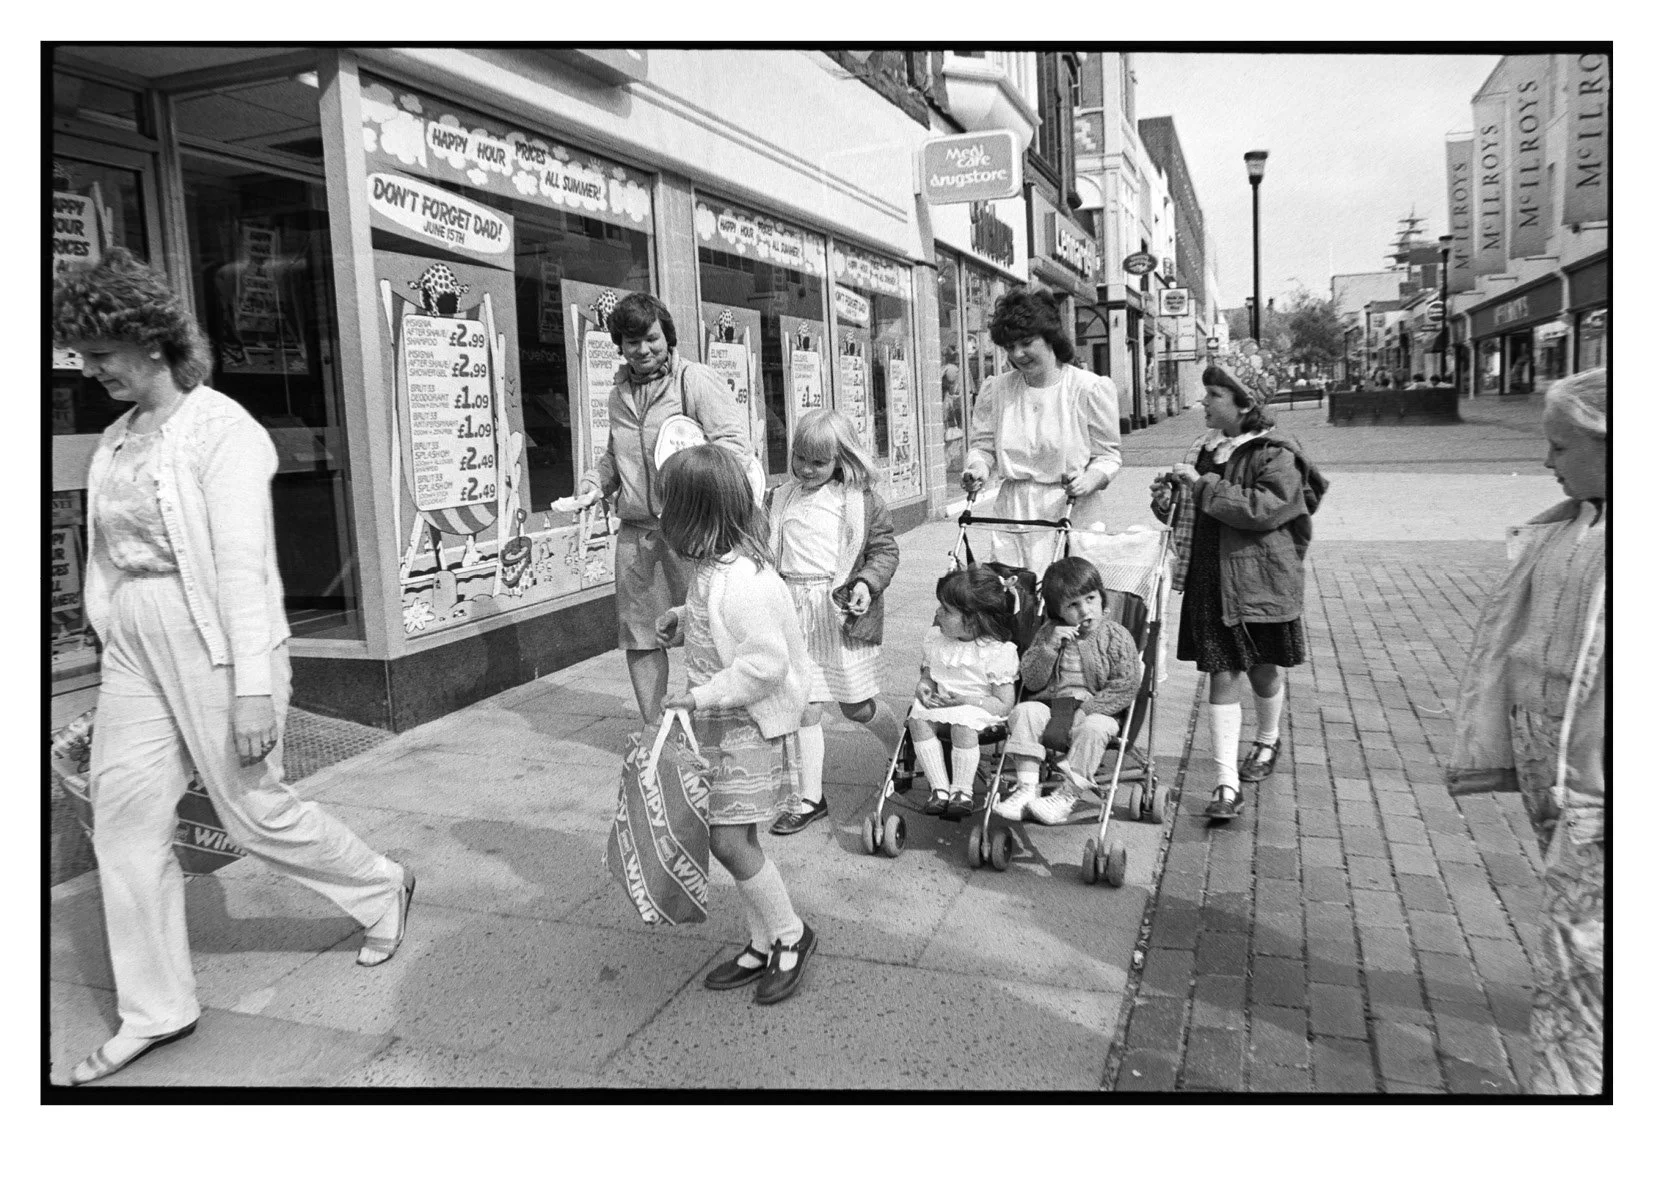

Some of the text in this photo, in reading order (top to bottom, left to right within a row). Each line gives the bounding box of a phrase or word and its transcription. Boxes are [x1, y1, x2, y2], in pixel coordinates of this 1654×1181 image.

[432, 128, 546, 167] HAPPY HOUR PRICES
[545, 170, 602, 202] ALL SUMMER!
[930, 169, 1008, 188] drugstore
[374, 177, 504, 242] DON'T FORGET DAD!
[53, 218, 85, 237] OUR
[422, 220, 466, 246] JUNE 15TH
[449, 324, 485, 348] £2.99
[452, 354, 487, 378] £2.99
[454, 385, 489, 409] £1.09
[457, 414, 492, 439] £1.09
[460, 446, 494, 472] £2.49
[460, 477, 496, 502] £2.49
[627, 854, 661, 923] WIMP
